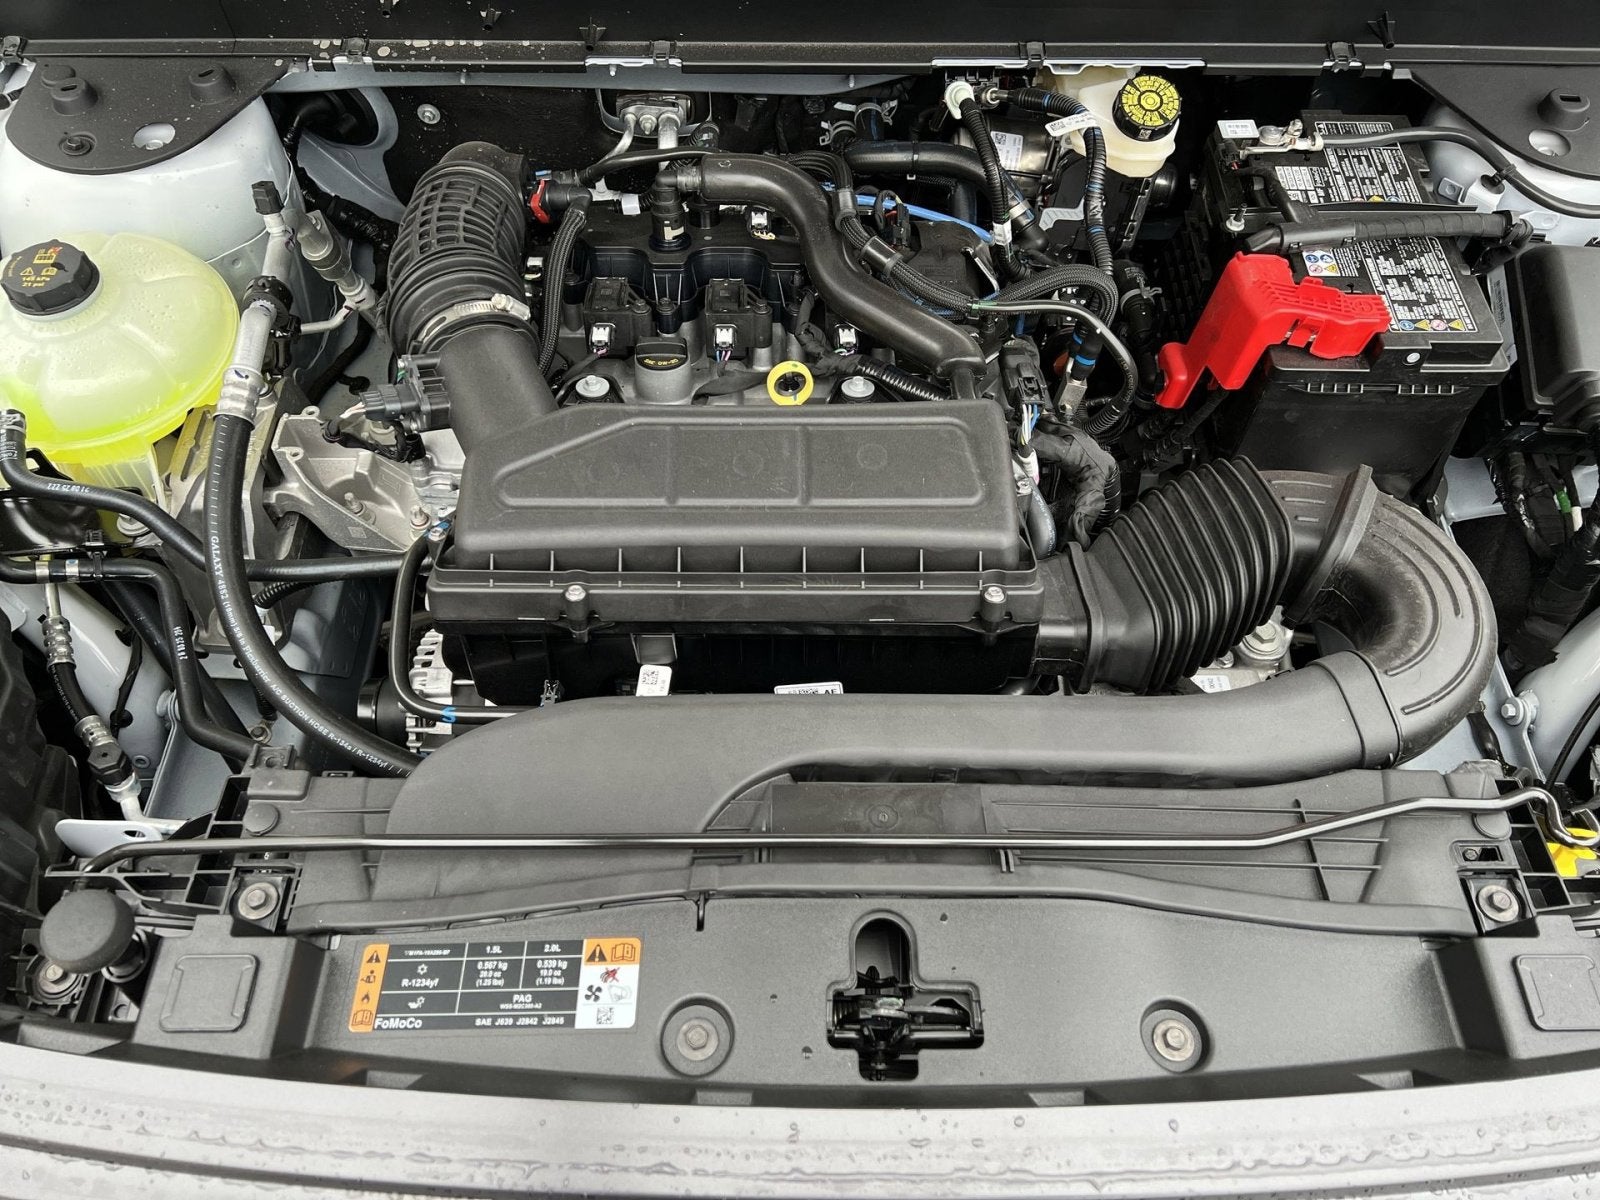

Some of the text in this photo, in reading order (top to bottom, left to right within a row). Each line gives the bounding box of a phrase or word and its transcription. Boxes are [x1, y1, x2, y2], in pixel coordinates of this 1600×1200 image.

[210, 536, 224, 578] GALAXY
[243, 645, 271, 683] Flexbarrier
[281, 695, 310, 720] SUCTION
[308, 718, 329, 735] HOSE
[486, 945, 502, 954] 1.5L
[544, 944, 561, 952] 2.0L
[498, 960, 508, 971] kg
[558, 959, 568, 970] kg
[401, 978, 439, 989] R-1234yf
[513, 994, 532, 1003] PAG
[374, 1017, 423, 1029] FoMoCo
[475, 1018, 492, 1026] SAE
